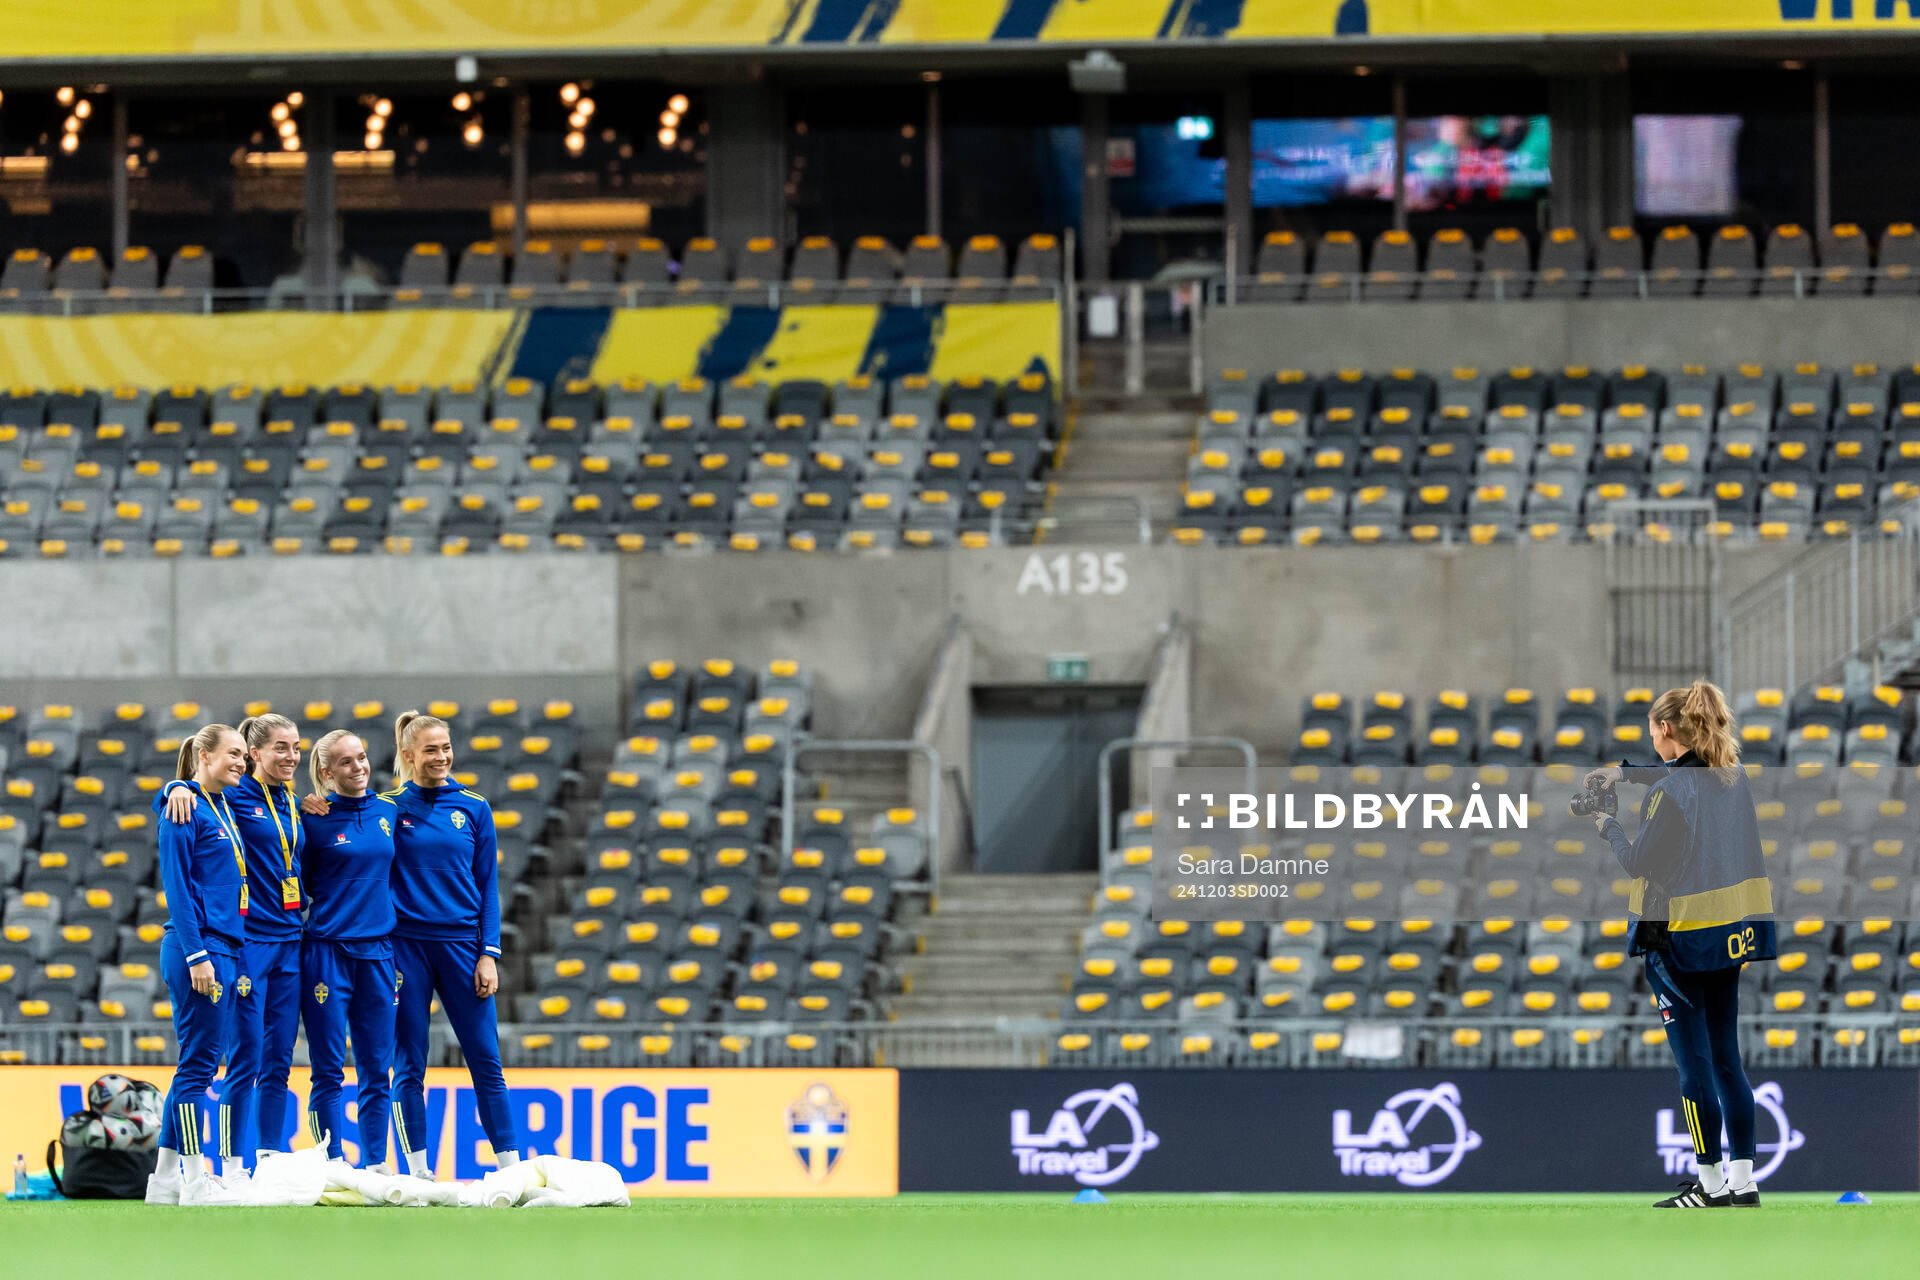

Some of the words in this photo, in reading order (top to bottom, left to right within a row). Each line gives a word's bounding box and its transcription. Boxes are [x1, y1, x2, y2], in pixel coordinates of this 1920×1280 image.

[1016, 551, 1129, 595] A135
[1011, 1109, 1088, 1148] LA
[1333, 1109, 1410, 1148] LA
[1011, 1146, 1109, 1175] Travel
[1333, 1146, 1431, 1176] Travel
